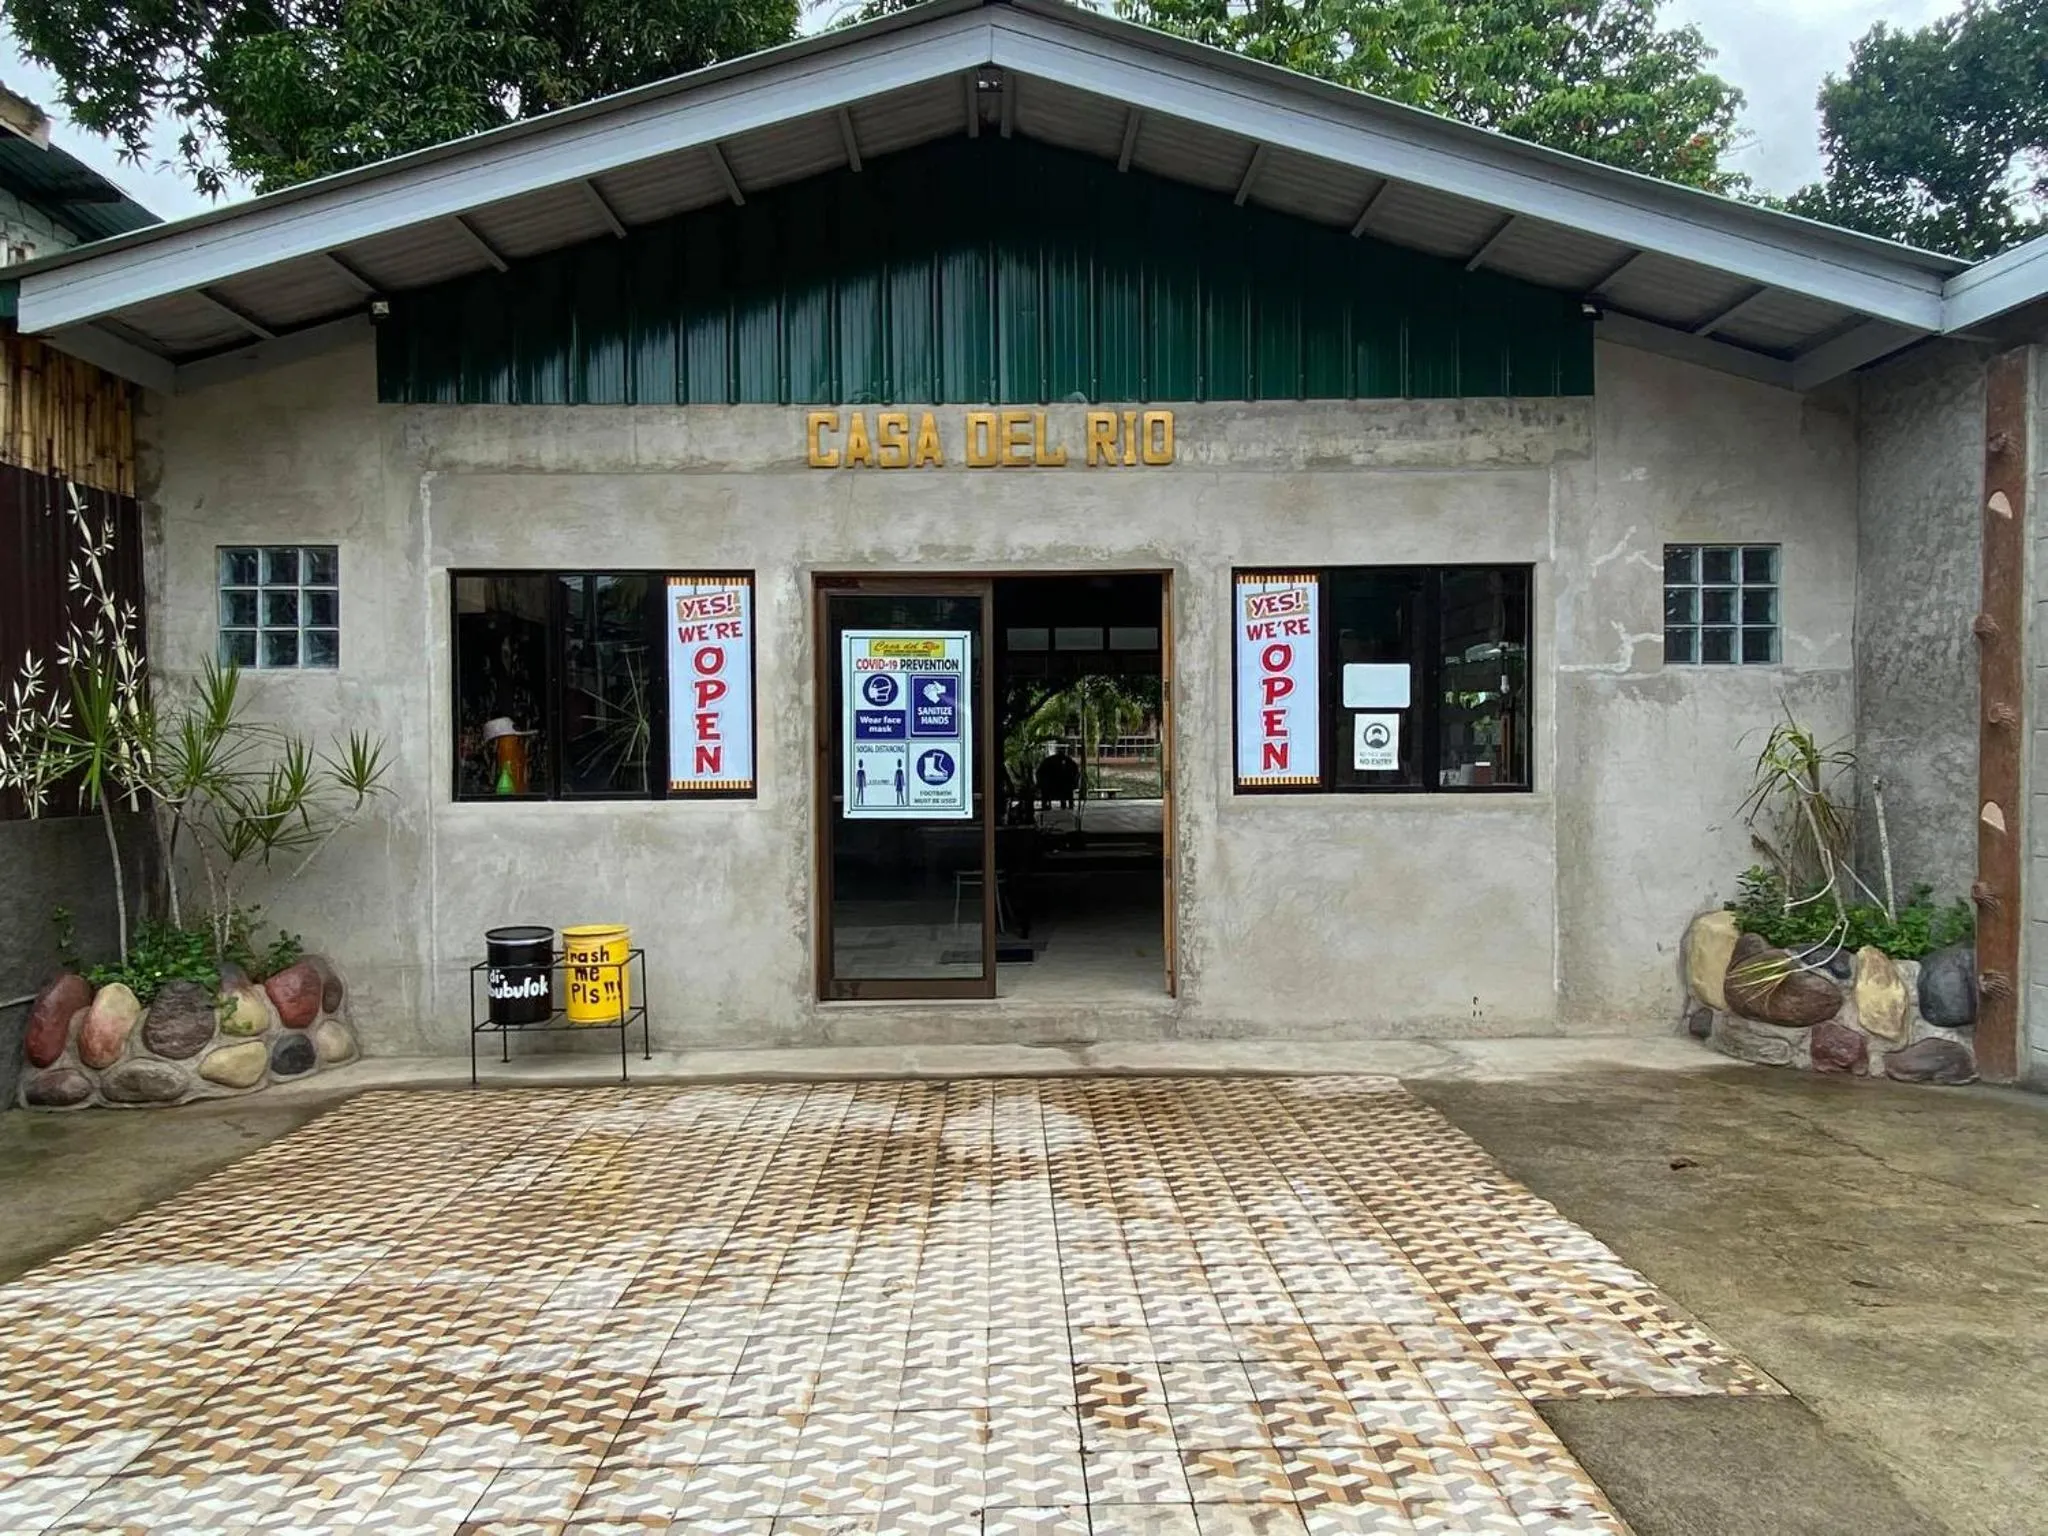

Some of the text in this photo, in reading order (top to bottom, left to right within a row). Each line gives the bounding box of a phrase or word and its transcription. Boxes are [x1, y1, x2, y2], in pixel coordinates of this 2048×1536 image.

[807, 410, 1174, 468] CASA DEL RIO
[683, 594, 733, 618] YES!
[1251, 592, 1302, 616] YES!
[678, 621, 743, 643] WE'RE
[1246, 618, 1311, 641] WE'RE
[856, 659, 959, 671] COVID-19 PREVENTION
[694, 647, 727, 774] OPEN
[917, 706, 953, 715] SANITIZE
[1262, 644, 1293, 770] OPEN
[860, 715, 902, 724] Wear face
[869, 725, 892, 733] mask
[921, 716, 950, 725] HANDS
[575, 966, 600, 982] me
